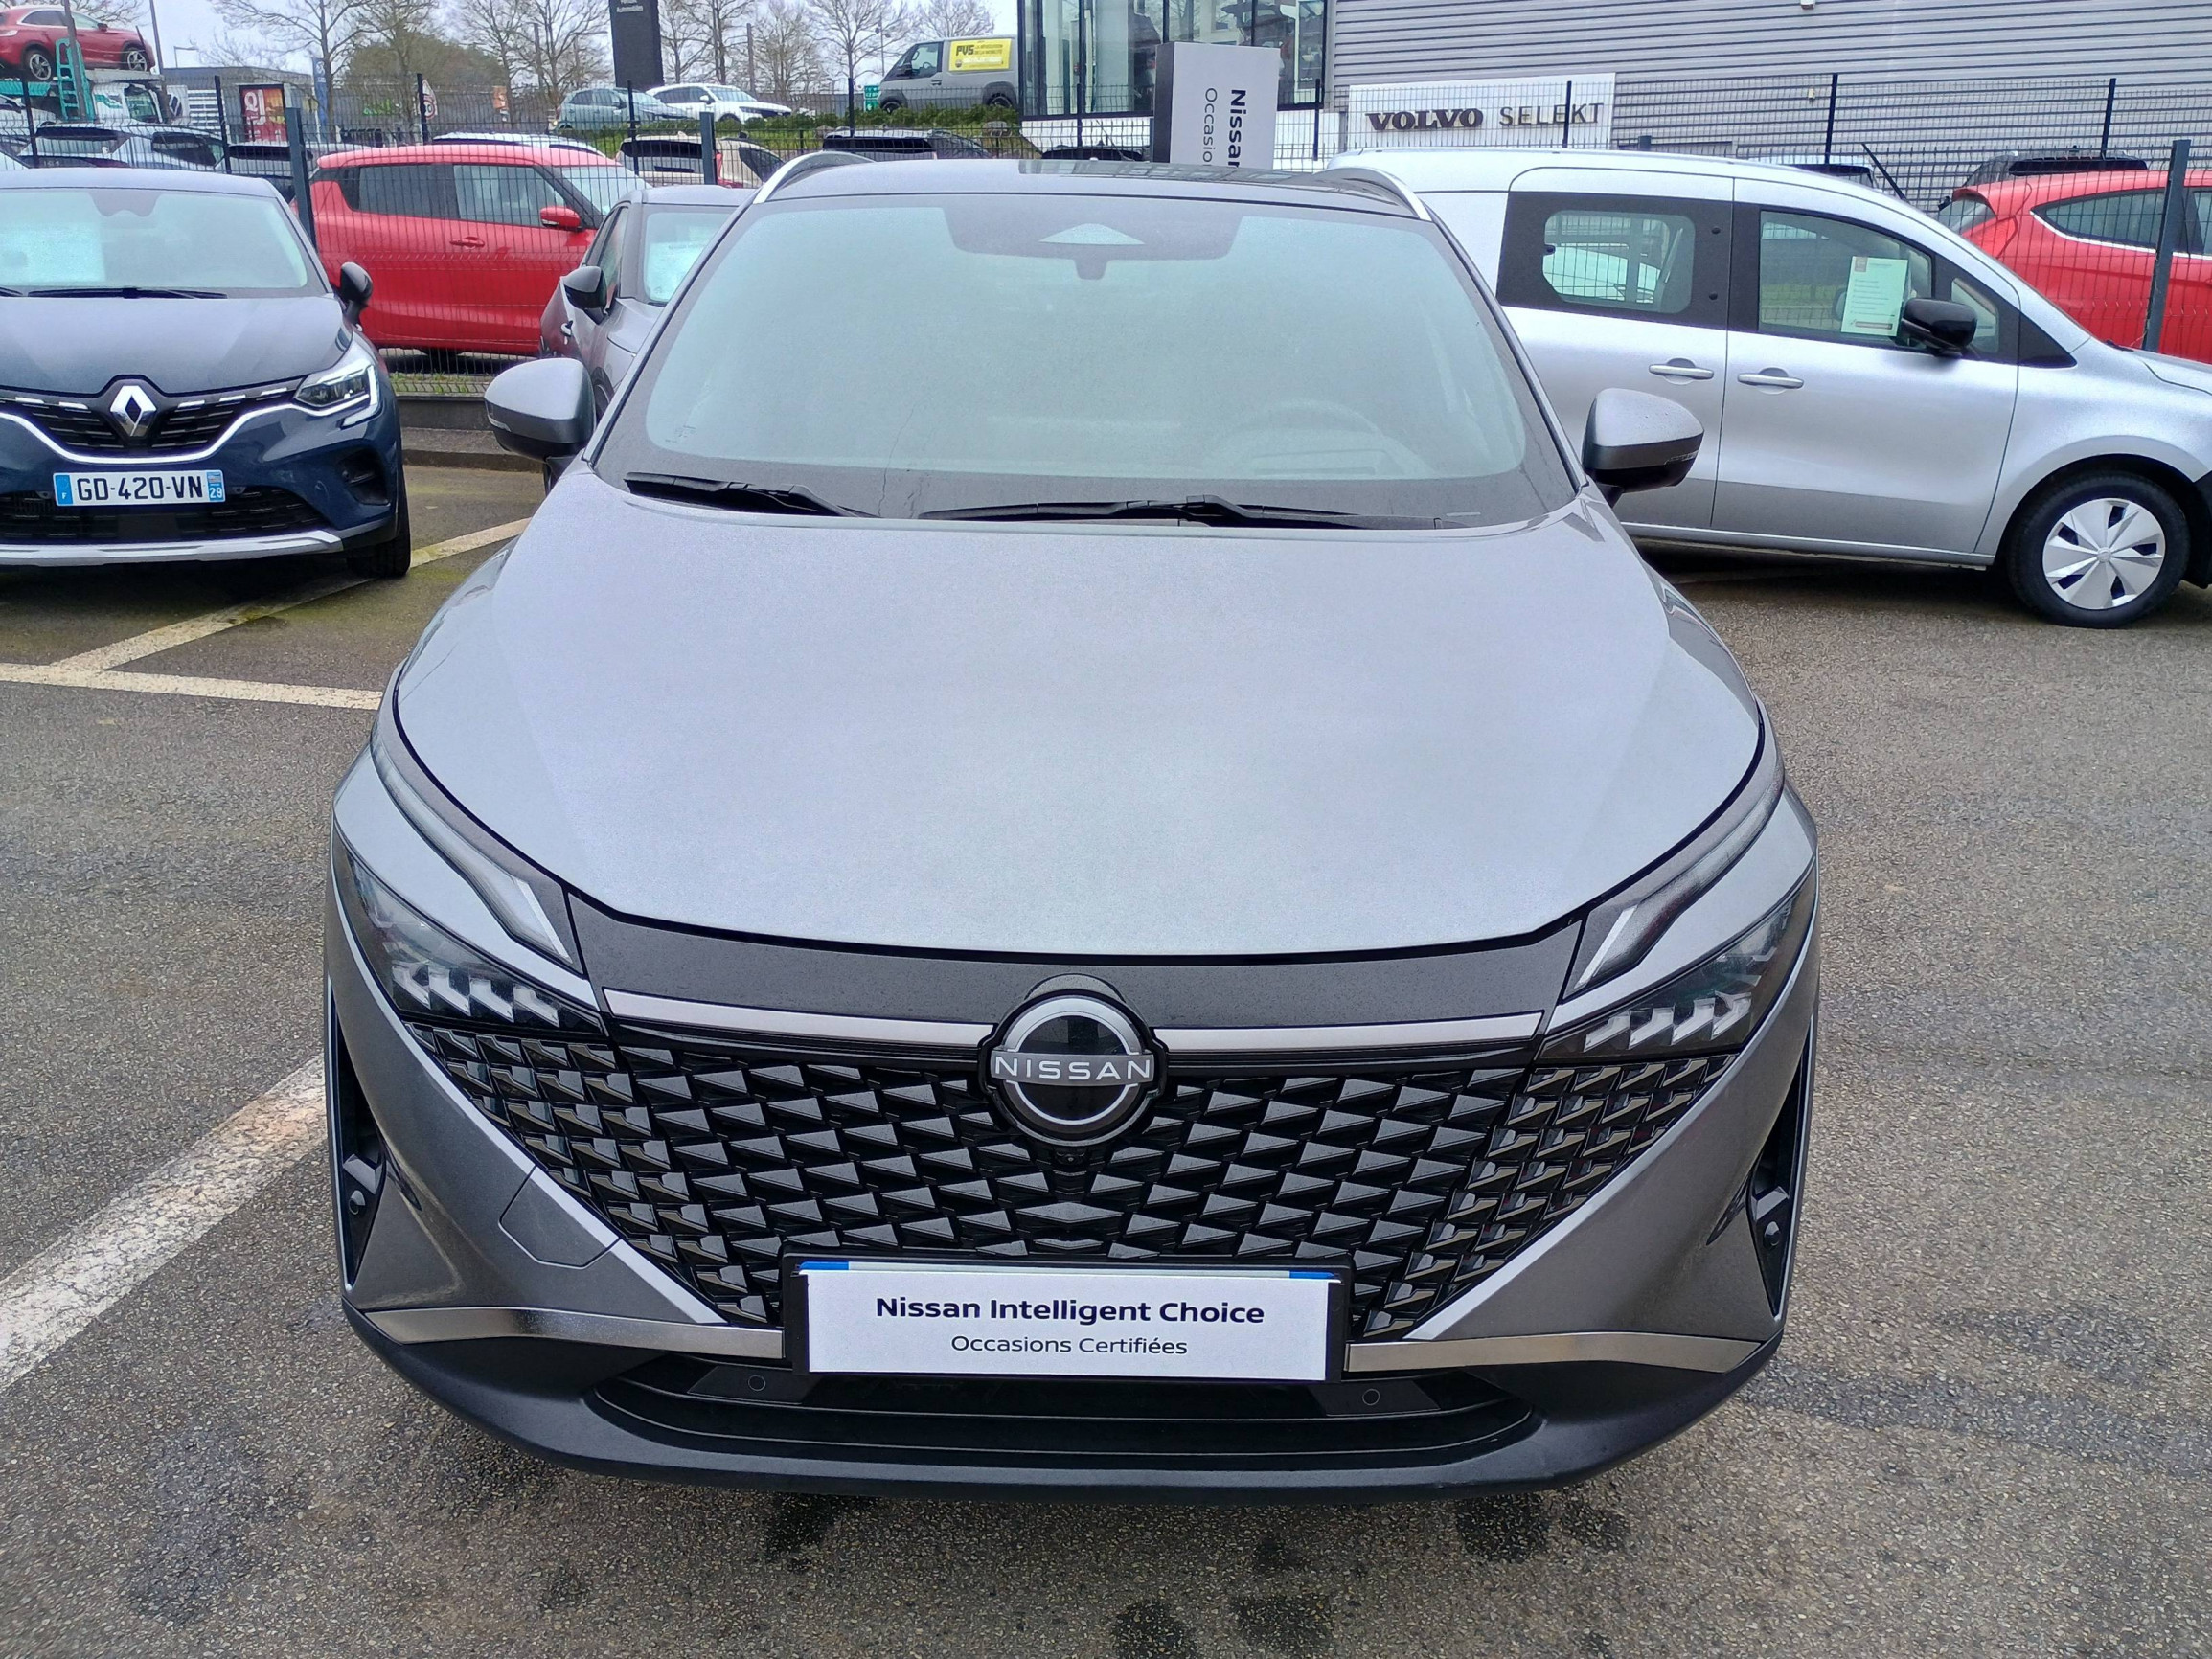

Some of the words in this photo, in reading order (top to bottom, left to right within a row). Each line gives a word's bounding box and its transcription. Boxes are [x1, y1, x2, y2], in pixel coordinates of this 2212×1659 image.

[1202, 88, 1218, 167] Occasio
[1365, 108, 1484, 130] VOLVO
[1499, 102, 1605, 126] SELEKT
[77, 476, 203, 501] GD-420-VN
[209, 487, 223, 499] 29
[994, 1056, 1151, 1080] NISSAN
[876, 1297, 981, 1319] Nissan
[990, 1299, 1152, 1326] Intelligent
[1159, 1302, 1266, 1324] Choice
[950, 1335, 1073, 1353] Occasions
[1079, 1337, 1189, 1355] Certifiées
